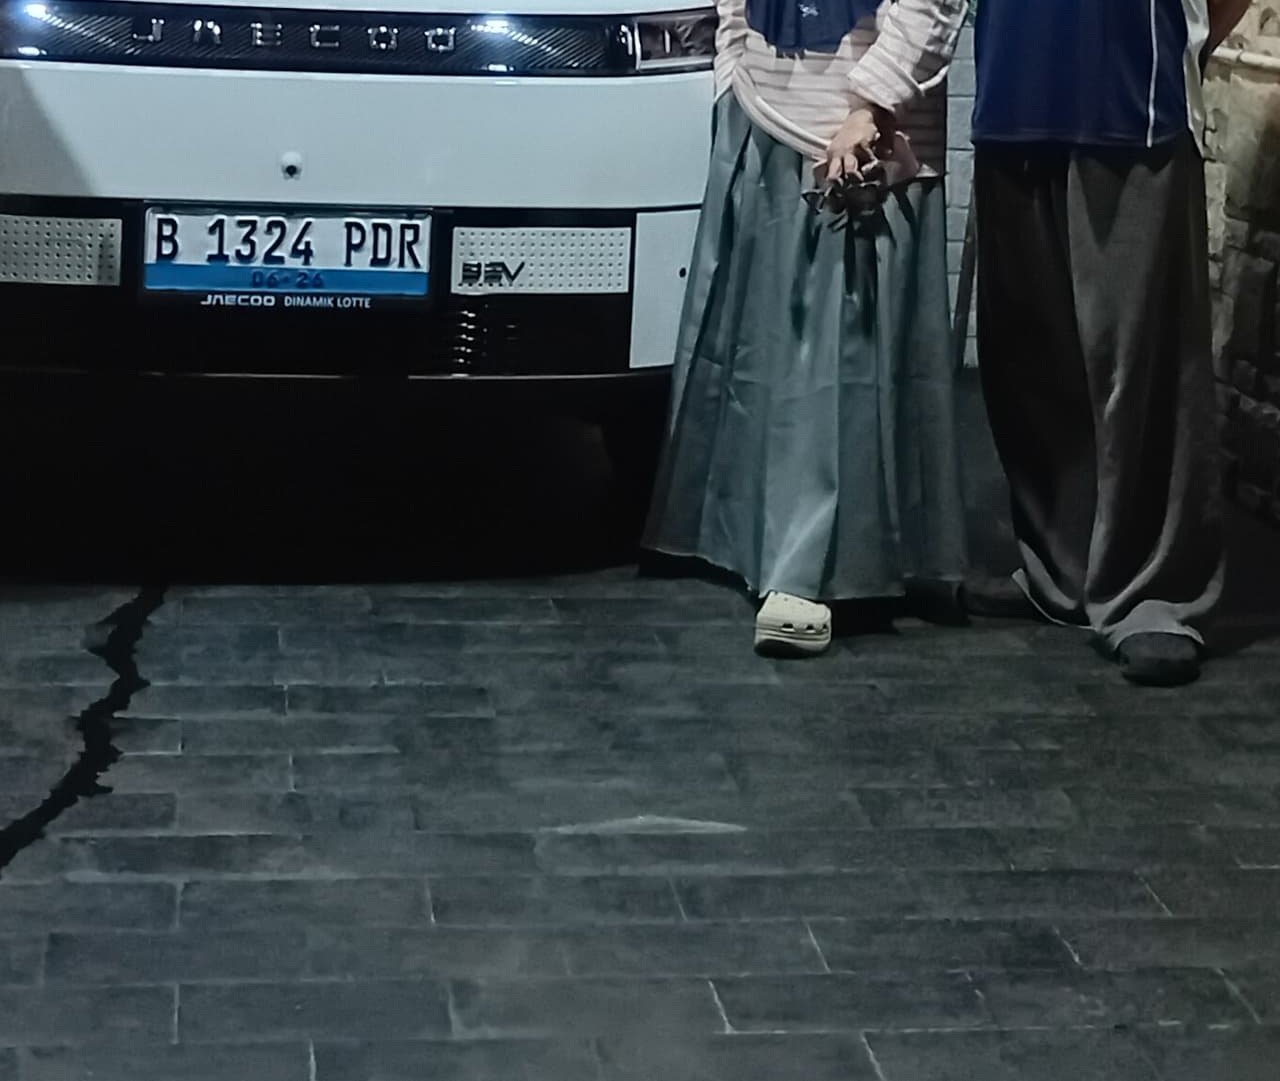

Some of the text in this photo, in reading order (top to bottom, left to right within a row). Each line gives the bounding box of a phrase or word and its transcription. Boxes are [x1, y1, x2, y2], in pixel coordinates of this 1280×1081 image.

[156, 217, 422, 269] B 1324 PDR
[462, 261, 525, 284] BEV
[200, 294, 371, 309] JAECOO DINAMIK LOTTE
